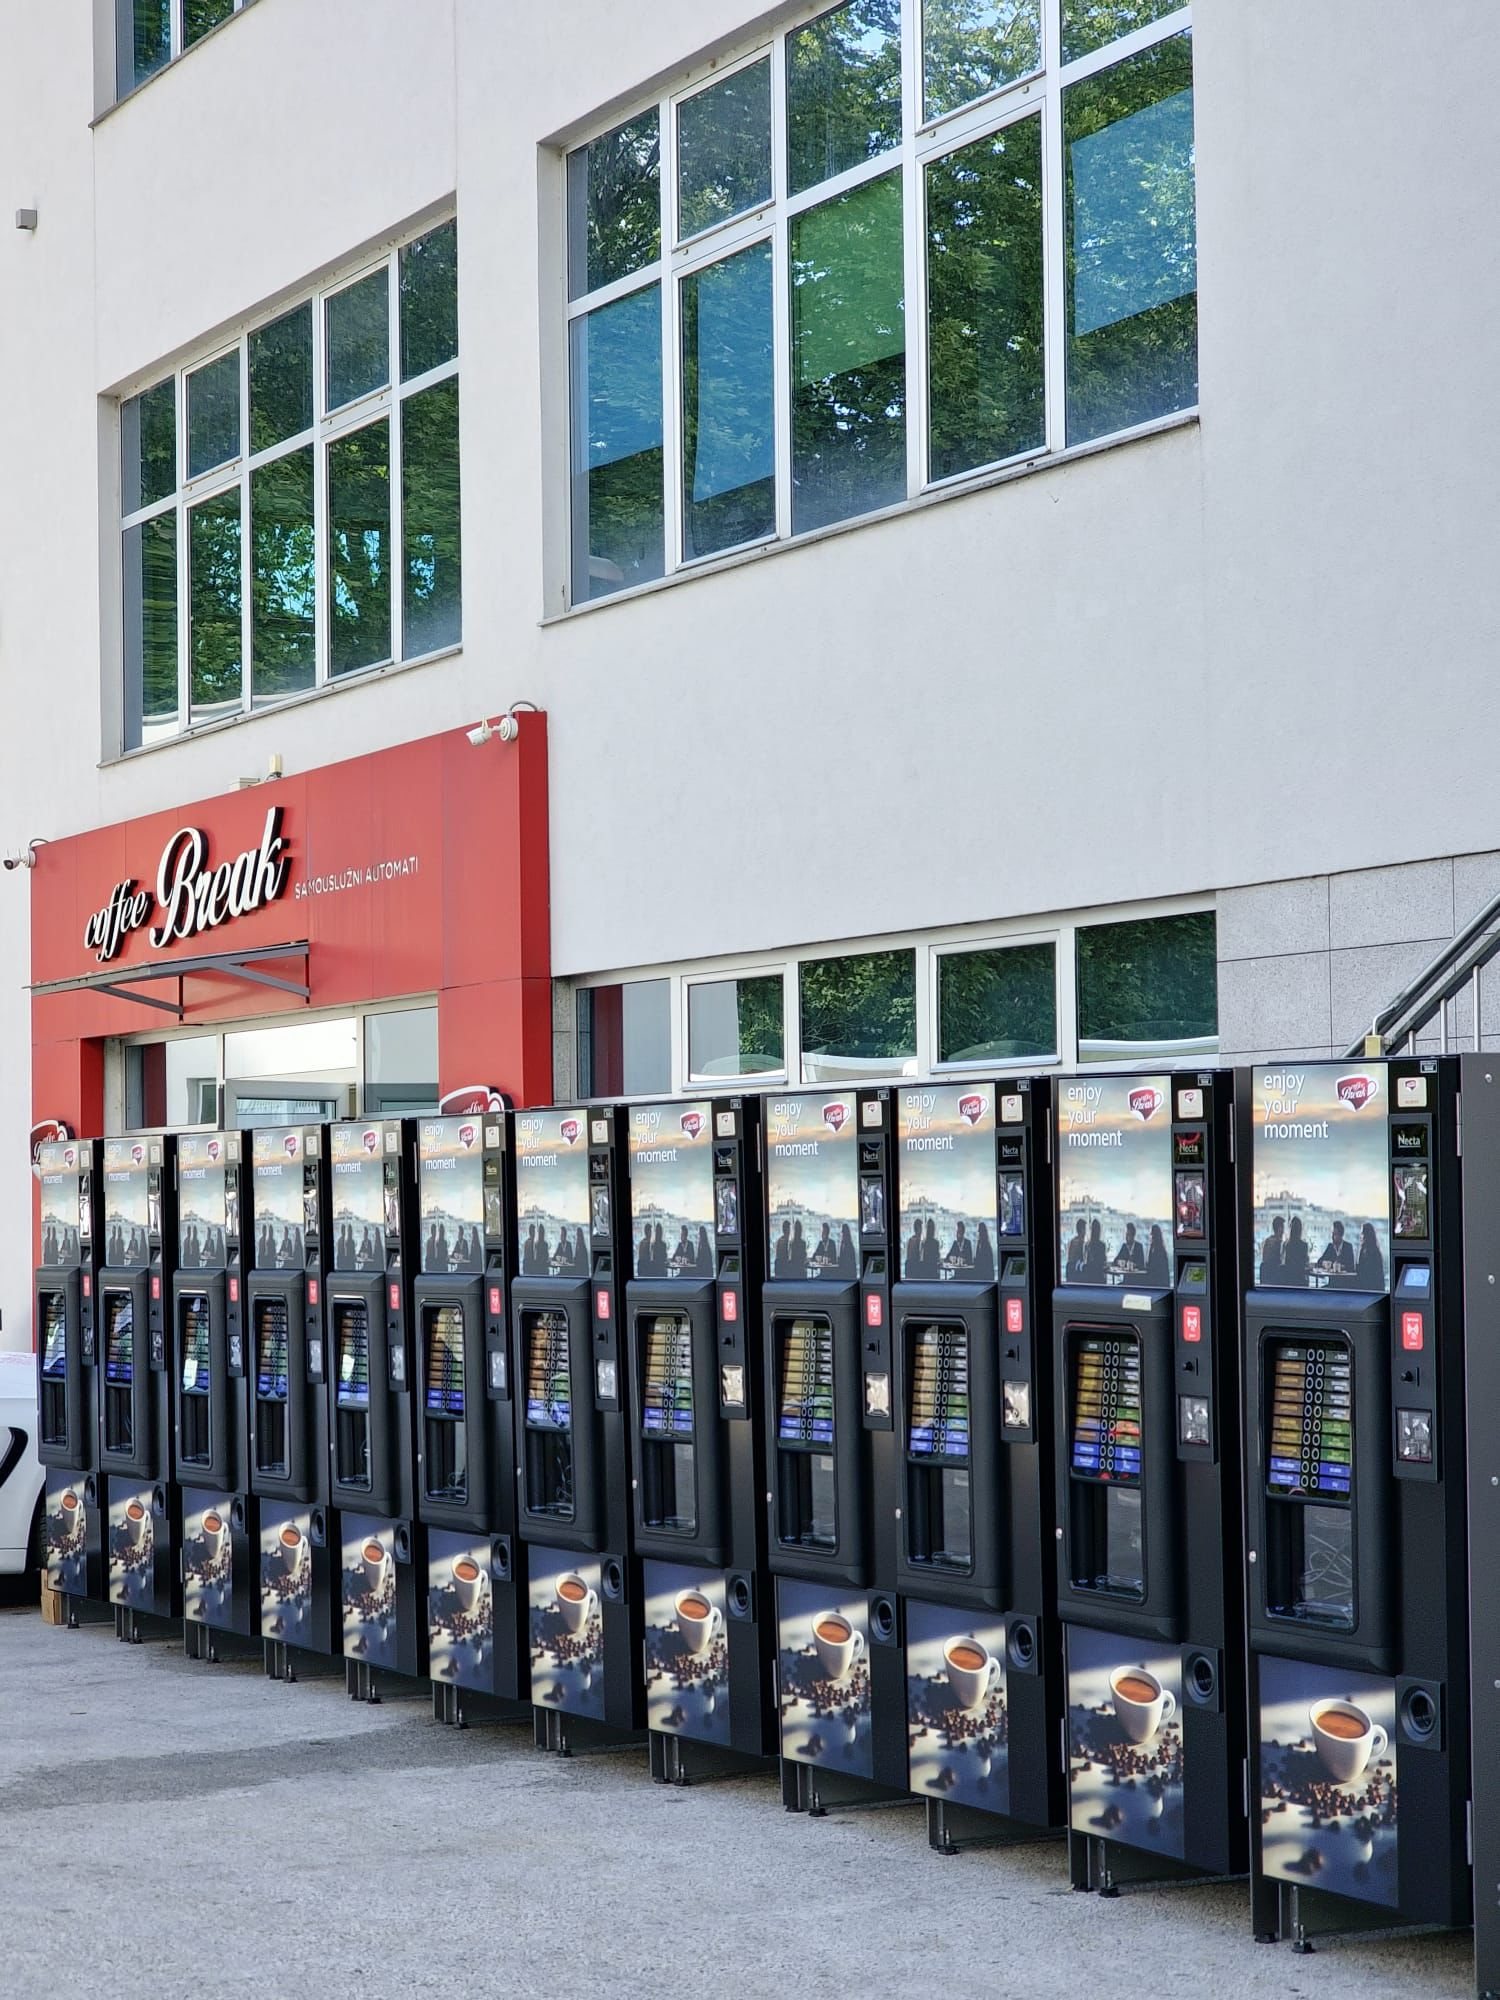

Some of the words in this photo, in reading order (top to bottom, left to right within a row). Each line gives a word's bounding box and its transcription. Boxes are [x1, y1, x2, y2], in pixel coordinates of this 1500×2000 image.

[84, 878, 148, 961] coffee
[149, 806, 284, 949] Break
[295, 866, 363, 900] SAMOUSLUŽNI
[365, 856, 418, 884] AUTOMATI
[1264, 1069, 1305, 1097] enjoy
[906, 1090, 937, 1113] enjoy
[1068, 1081, 1103, 1107] enjoy
[1340, 1086, 1368, 1102] Break
[635, 1107, 662, 1129] enjoy
[774, 1098, 802, 1120] enjoy
[1264, 1099, 1299, 1121] your
[521, 1115, 544, 1134] enjoy
[906, 1116, 931, 1135] your
[1068, 1109, 1097, 1130] your
[424, 1122, 444, 1138] enjoy
[775, 1122, 799, 1142] your
[1069, 1129, 1123, 1147] moment
[1264, 1120, 1329, 1139] moment
[1397, 1130, 1421, 1146] Necta
[522, 1135, 540, 1152] your
[636, 1130, 658, 1148] your
[906, 1134, 954, 1151] moment
[1179, 1140, 1199, 1153] Necta
[636, 1148, 678, 1164] moment
[775, 1140, 819, 1157] moment
[335, 1161, 362, 1174] moment
[425, 1157, 456, 1171] moment
[522, 1152, 558, 1168] moment
